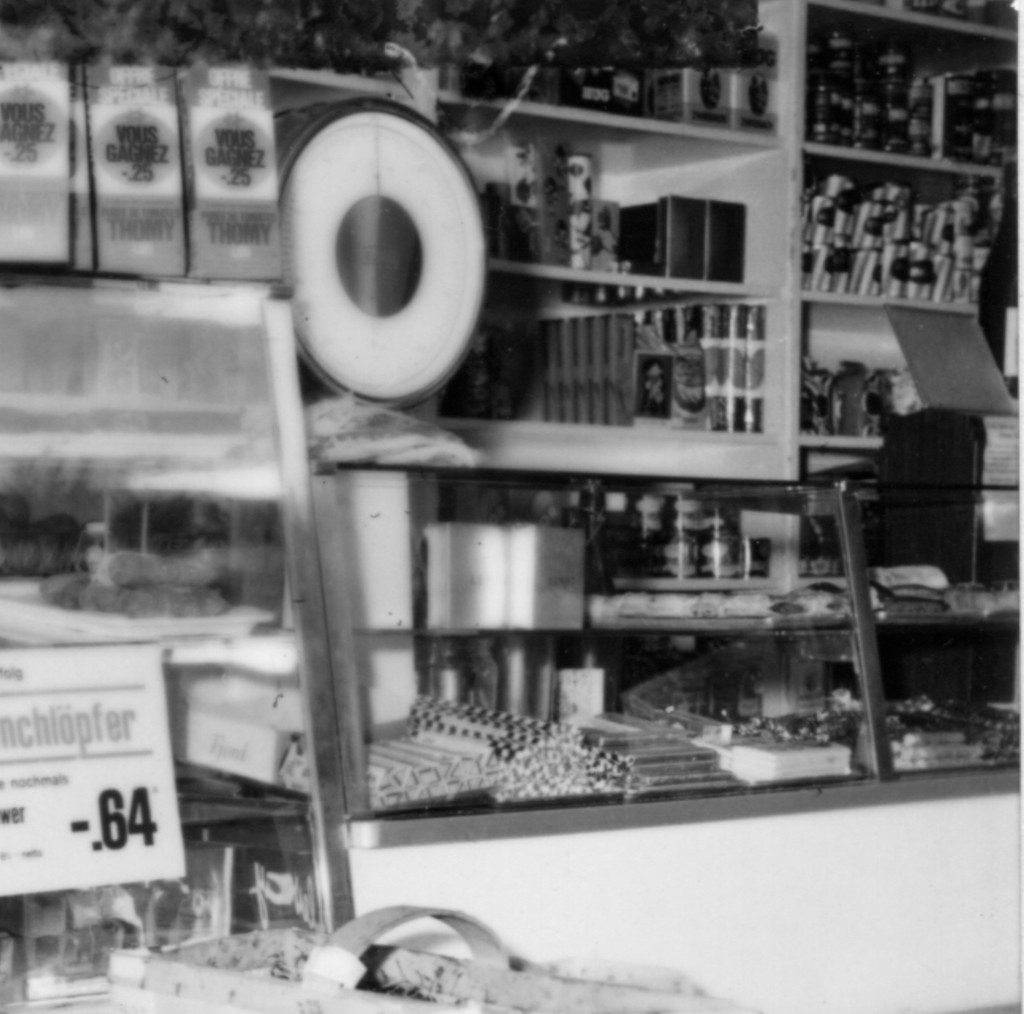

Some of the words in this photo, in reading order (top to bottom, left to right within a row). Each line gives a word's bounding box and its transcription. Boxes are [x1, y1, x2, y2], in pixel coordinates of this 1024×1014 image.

[0, 102, 45, 123] VOUS
[115, 124, 158, 145] VOUS
[214, 128, 255, 150] VOUS
[105, 144, 169, 164] GAGNEZ
[204, 147, 266, 168] GAGNEZ
[108, 219, 176, 242] THOMY
[207, 222, 274, 245] THOMY
[10, 772, 70, 791] nochmals
[70, 786, 158, 851] -.64
